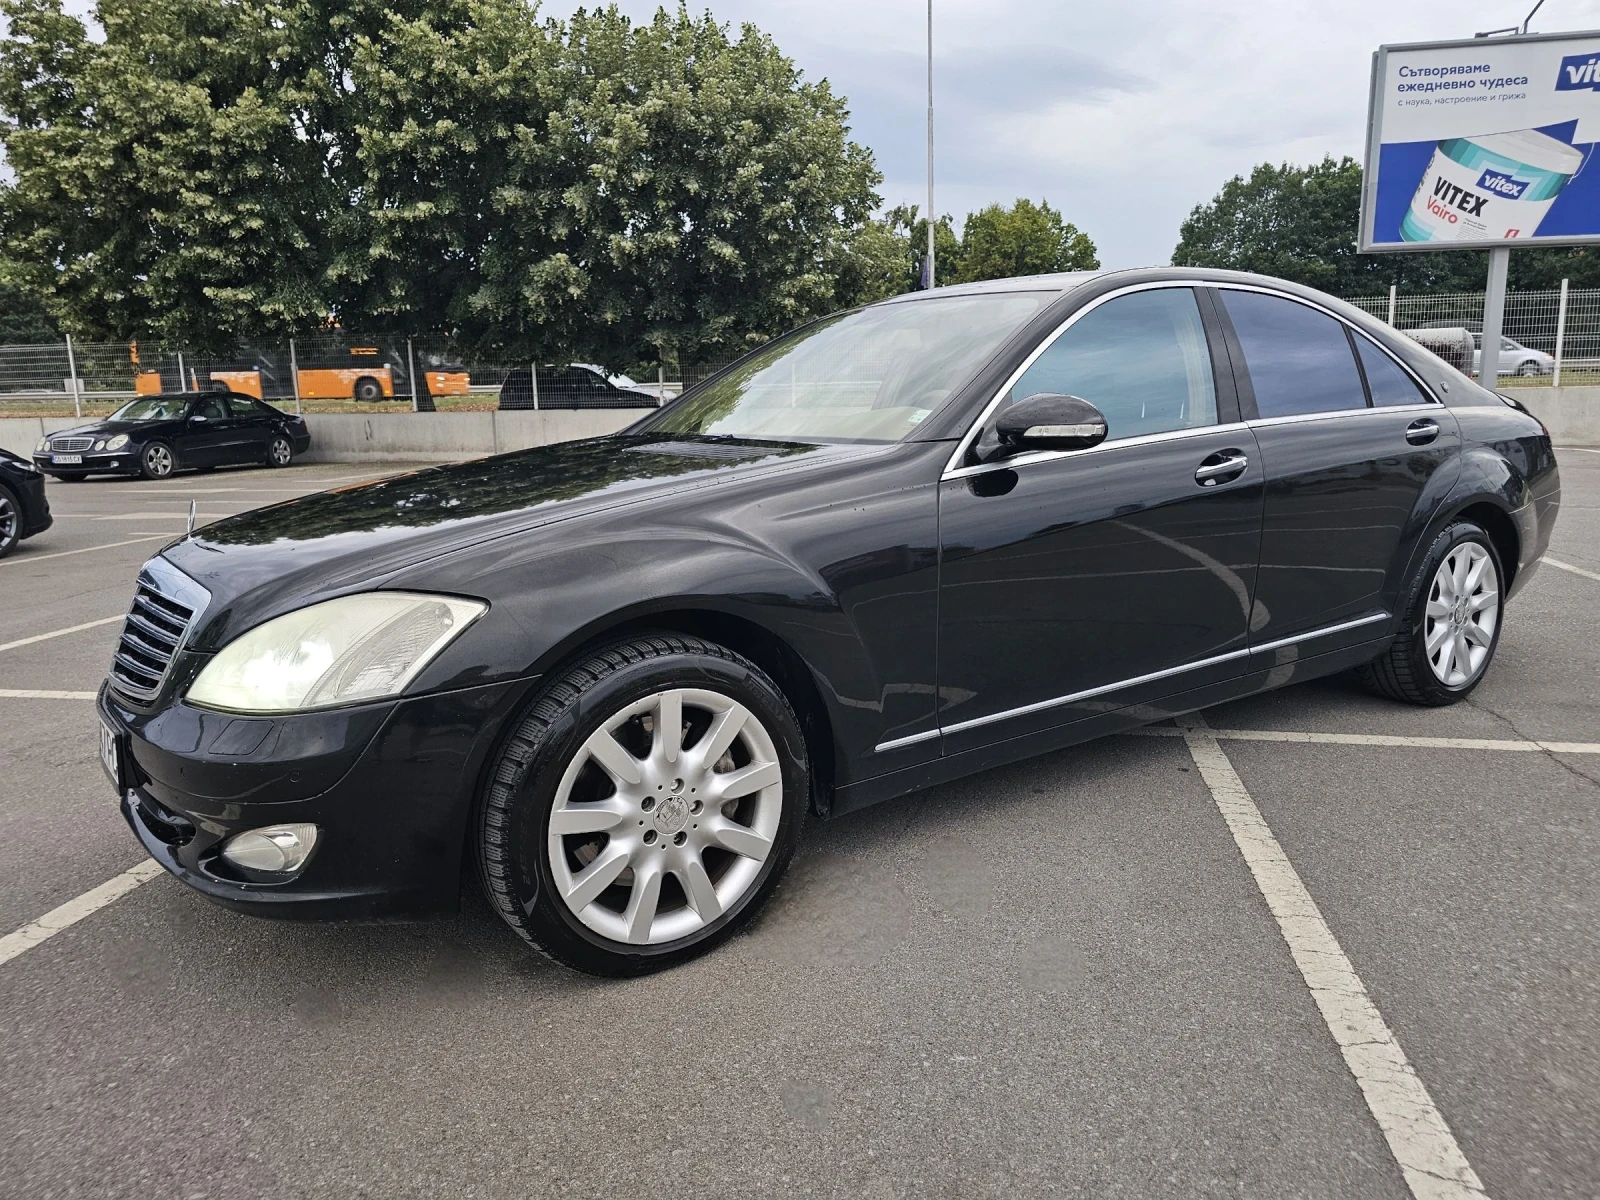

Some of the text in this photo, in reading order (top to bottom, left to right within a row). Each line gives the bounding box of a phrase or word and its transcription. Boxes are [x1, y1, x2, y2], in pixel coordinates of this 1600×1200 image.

[1398, 64, 1491, 78] Сътворяваме
[1397, 76, 1528, 93] ежедневно чудеса
[1405, 98, 1432, 107] наука,
[1434, 94, 1488, 104] настроение
[1498, 92, 1526, 101] грижа
[1483, 174, 1522, 196] vitex
[1433, 176, 1489, 217] VITEX
[1426, 195, 1458, 224] Vairo
